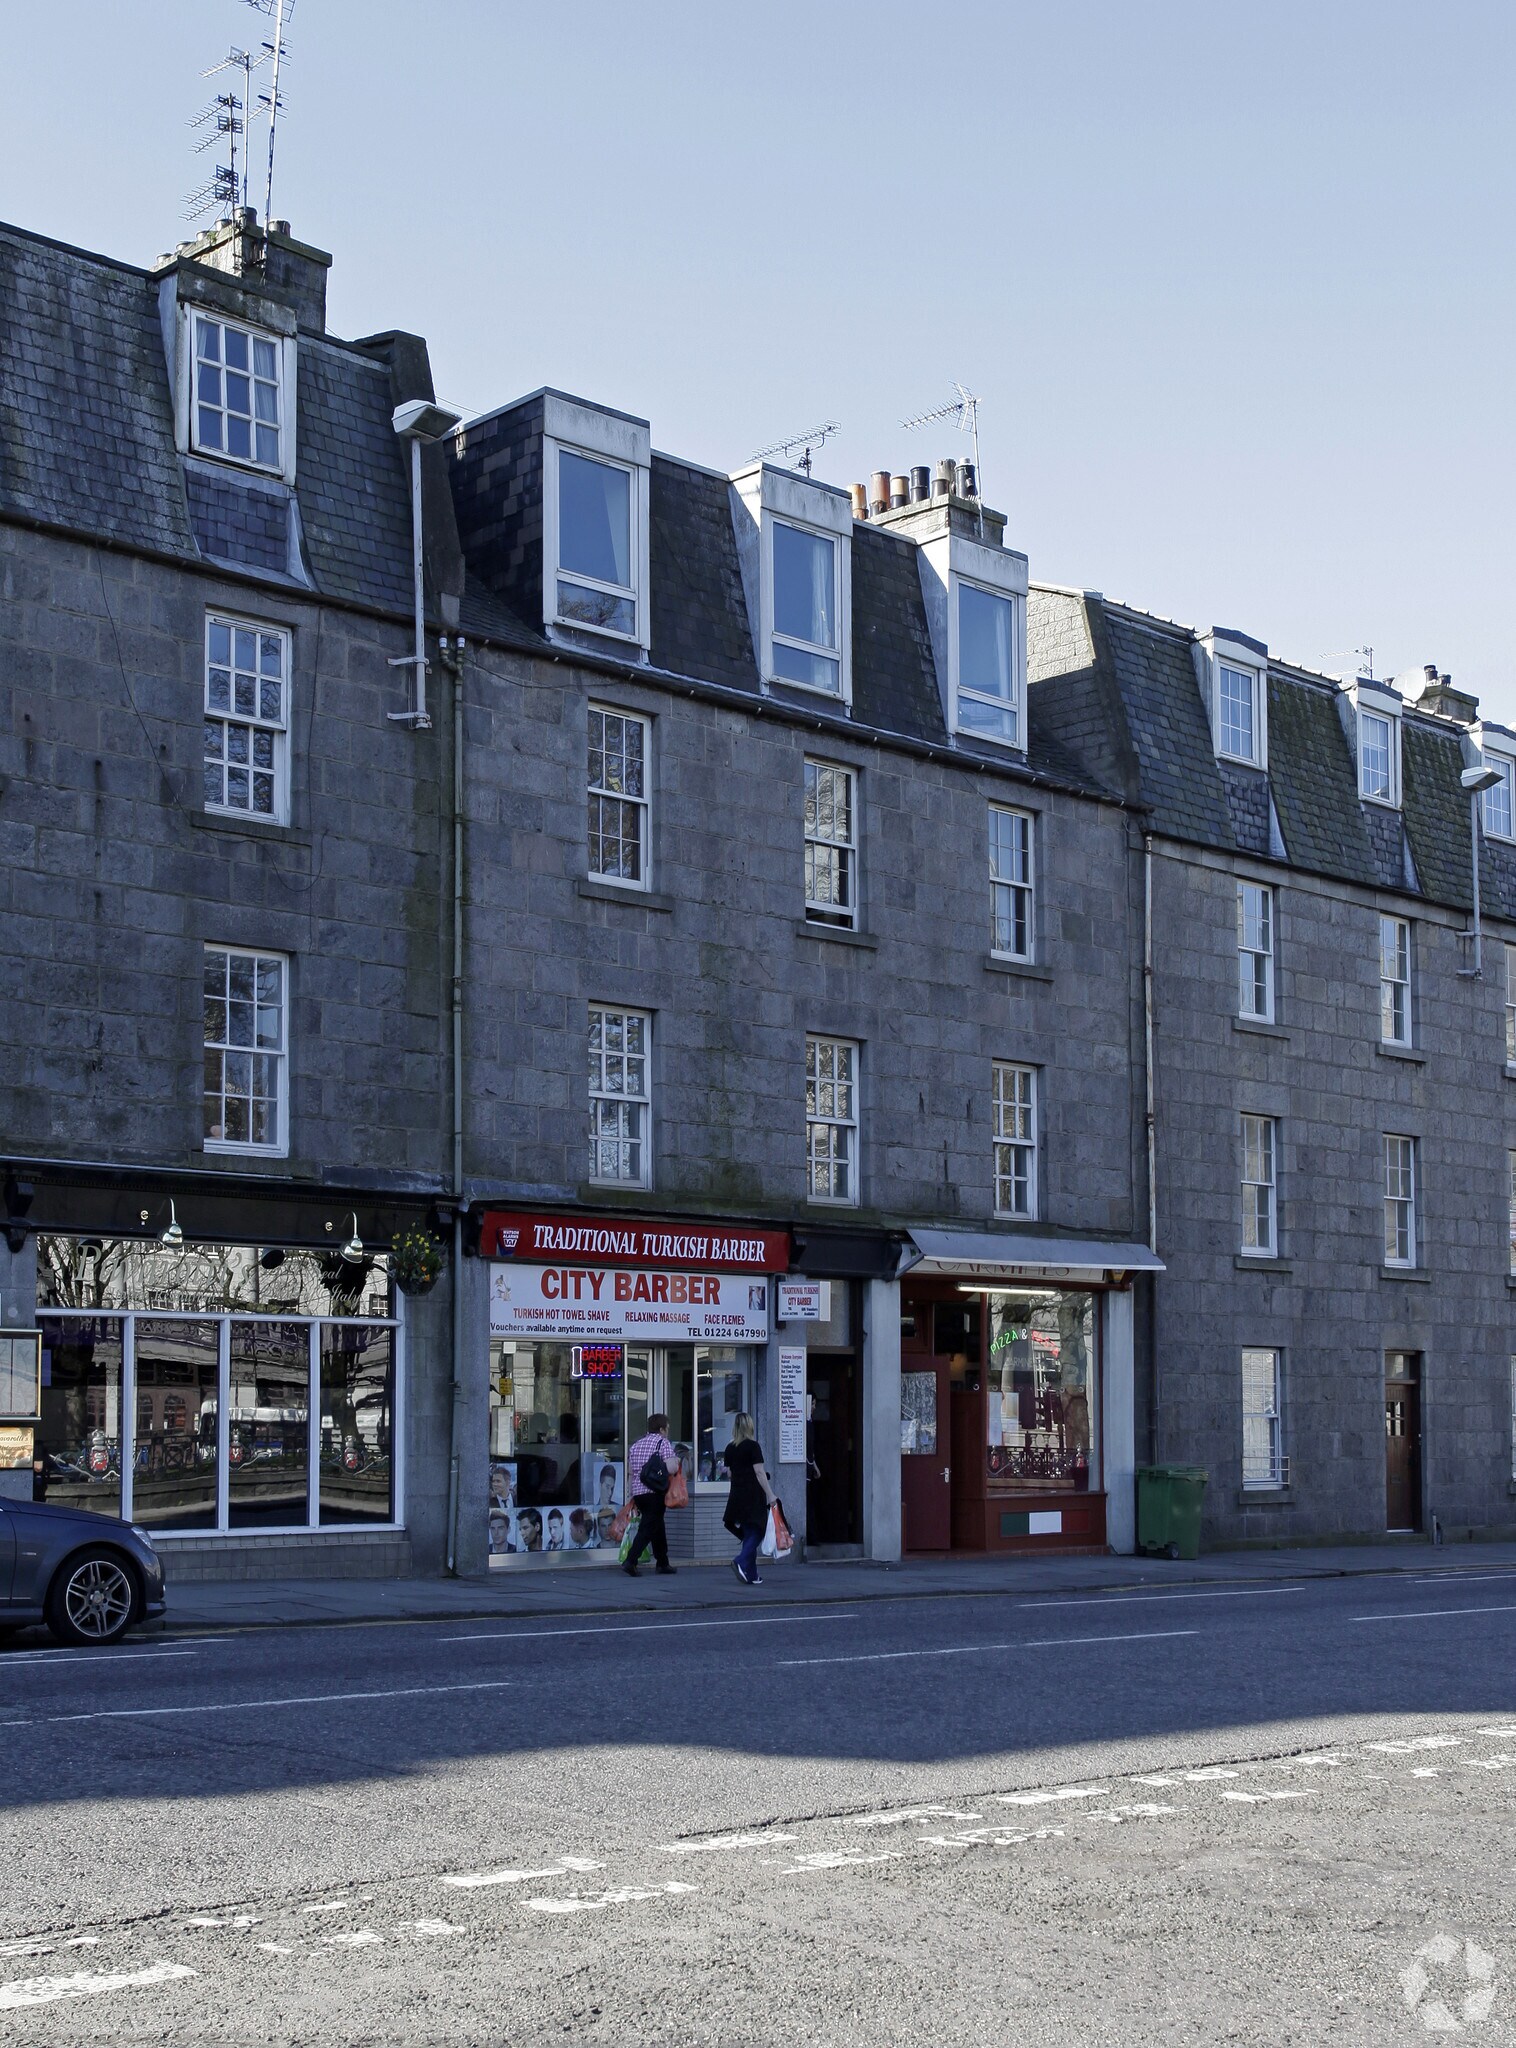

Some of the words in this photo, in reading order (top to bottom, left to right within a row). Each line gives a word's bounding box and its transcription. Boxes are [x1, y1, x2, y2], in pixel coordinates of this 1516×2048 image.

[533, 1225, 638, 1255] TRADITIONAL
[642, 1233, 709, 1259] TURKISH
[710, 1238, 766, 1262] BARBER
[540, 1268, 606, 1300] CITY
[614, 1272, 721, 1305] BARBER
[513, 1308, 544, 1319] TURKISH
[545, 1309, 560, 1320] HOT
[561, 1309, 586, 1321] TOWEL
[587, 1310, 610, 1321] SHAVE
[625, 1311, 658, 1323] RELAXING
[660, 1312, 690, 1324] MASSAGE
[704, 1314, 720, 1325] FACE
[721, 1314, 745, 1326] FLEMES
[490, 1322, 525, 1332] Vouchers
[526, 1324, 557, 1333] available
[557, 1325, 585, 1335] anytime
[586, 1326, 595, 1334] on
[596, 1326, 623, 1335] request
[687, 1327, 702, 1337] TEL
[704, 1328, 732, 1338] 01224
[733, 1328, 767, 1338] 647990
[990, 1330, 1018, 1355] PIZZA
[1021, 1328, 1028, 1340] &
[582, 1349, 621, 1361] BARBER
[587, 1362, 616, 1375] SHOP
